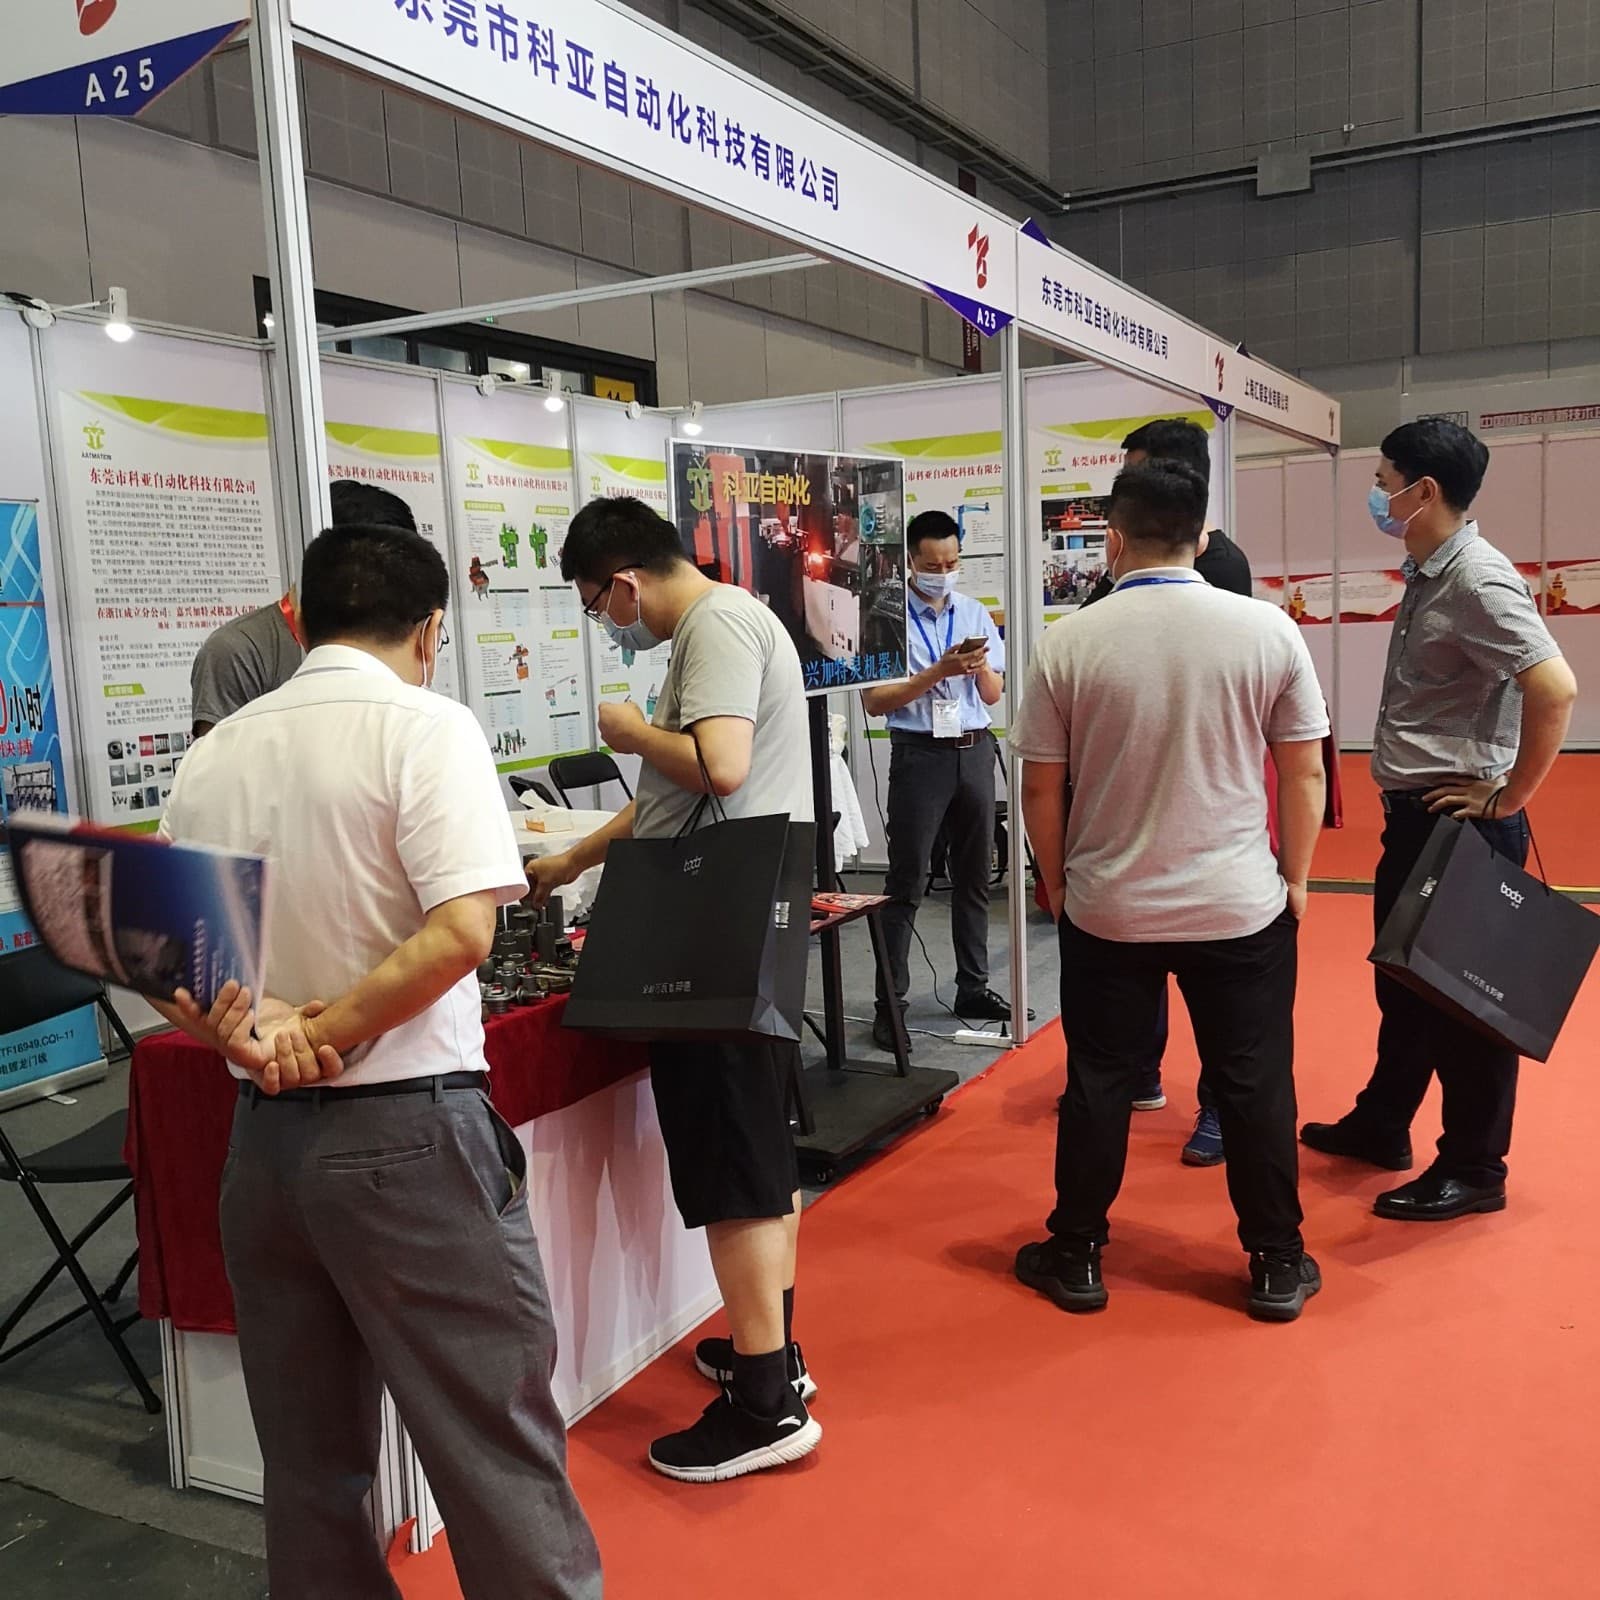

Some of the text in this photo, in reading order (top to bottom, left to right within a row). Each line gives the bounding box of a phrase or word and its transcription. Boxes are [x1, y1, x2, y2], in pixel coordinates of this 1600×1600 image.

[84, 57, 155, 107] A25
[976, 307, 996, 330] A25
[1041, 275, 1169, 360] 东莞市科亚自动化科技有限公司
[90, 467, 257, 495] 东莞市科亚自动化科技有限公司
[722, 470, 811, 506] 科亚自动化
[905, 463, 1002, 482] 市科亚自动化科技有限公
[800, 651, 905, 689] 兴加特灵机器人
